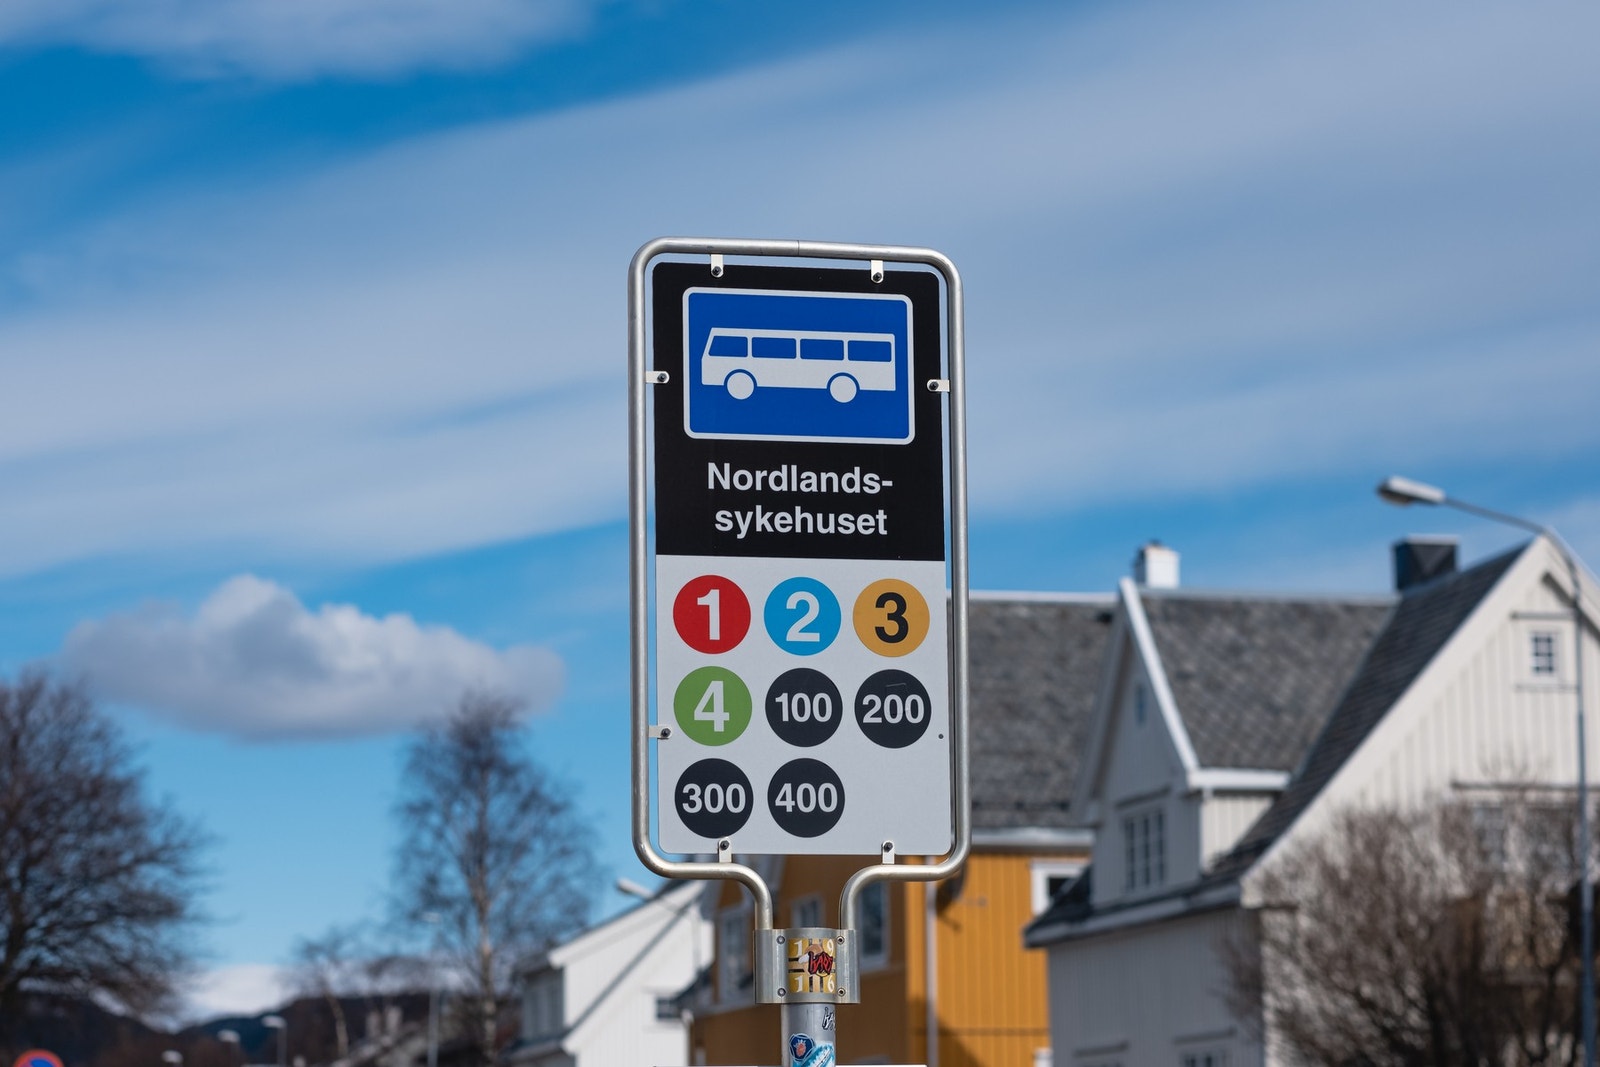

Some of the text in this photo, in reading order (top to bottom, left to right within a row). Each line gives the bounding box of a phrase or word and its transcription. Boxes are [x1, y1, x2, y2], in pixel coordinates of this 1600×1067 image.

[708, 462, 893, 494] Nordlands-
[714, 504, 888, 539] sykehuset
[697, 589, 910, 644] 1 2 3
[693, 680, 925, 733] 4 100 200
[682, 782, 838, 814] 300 400
